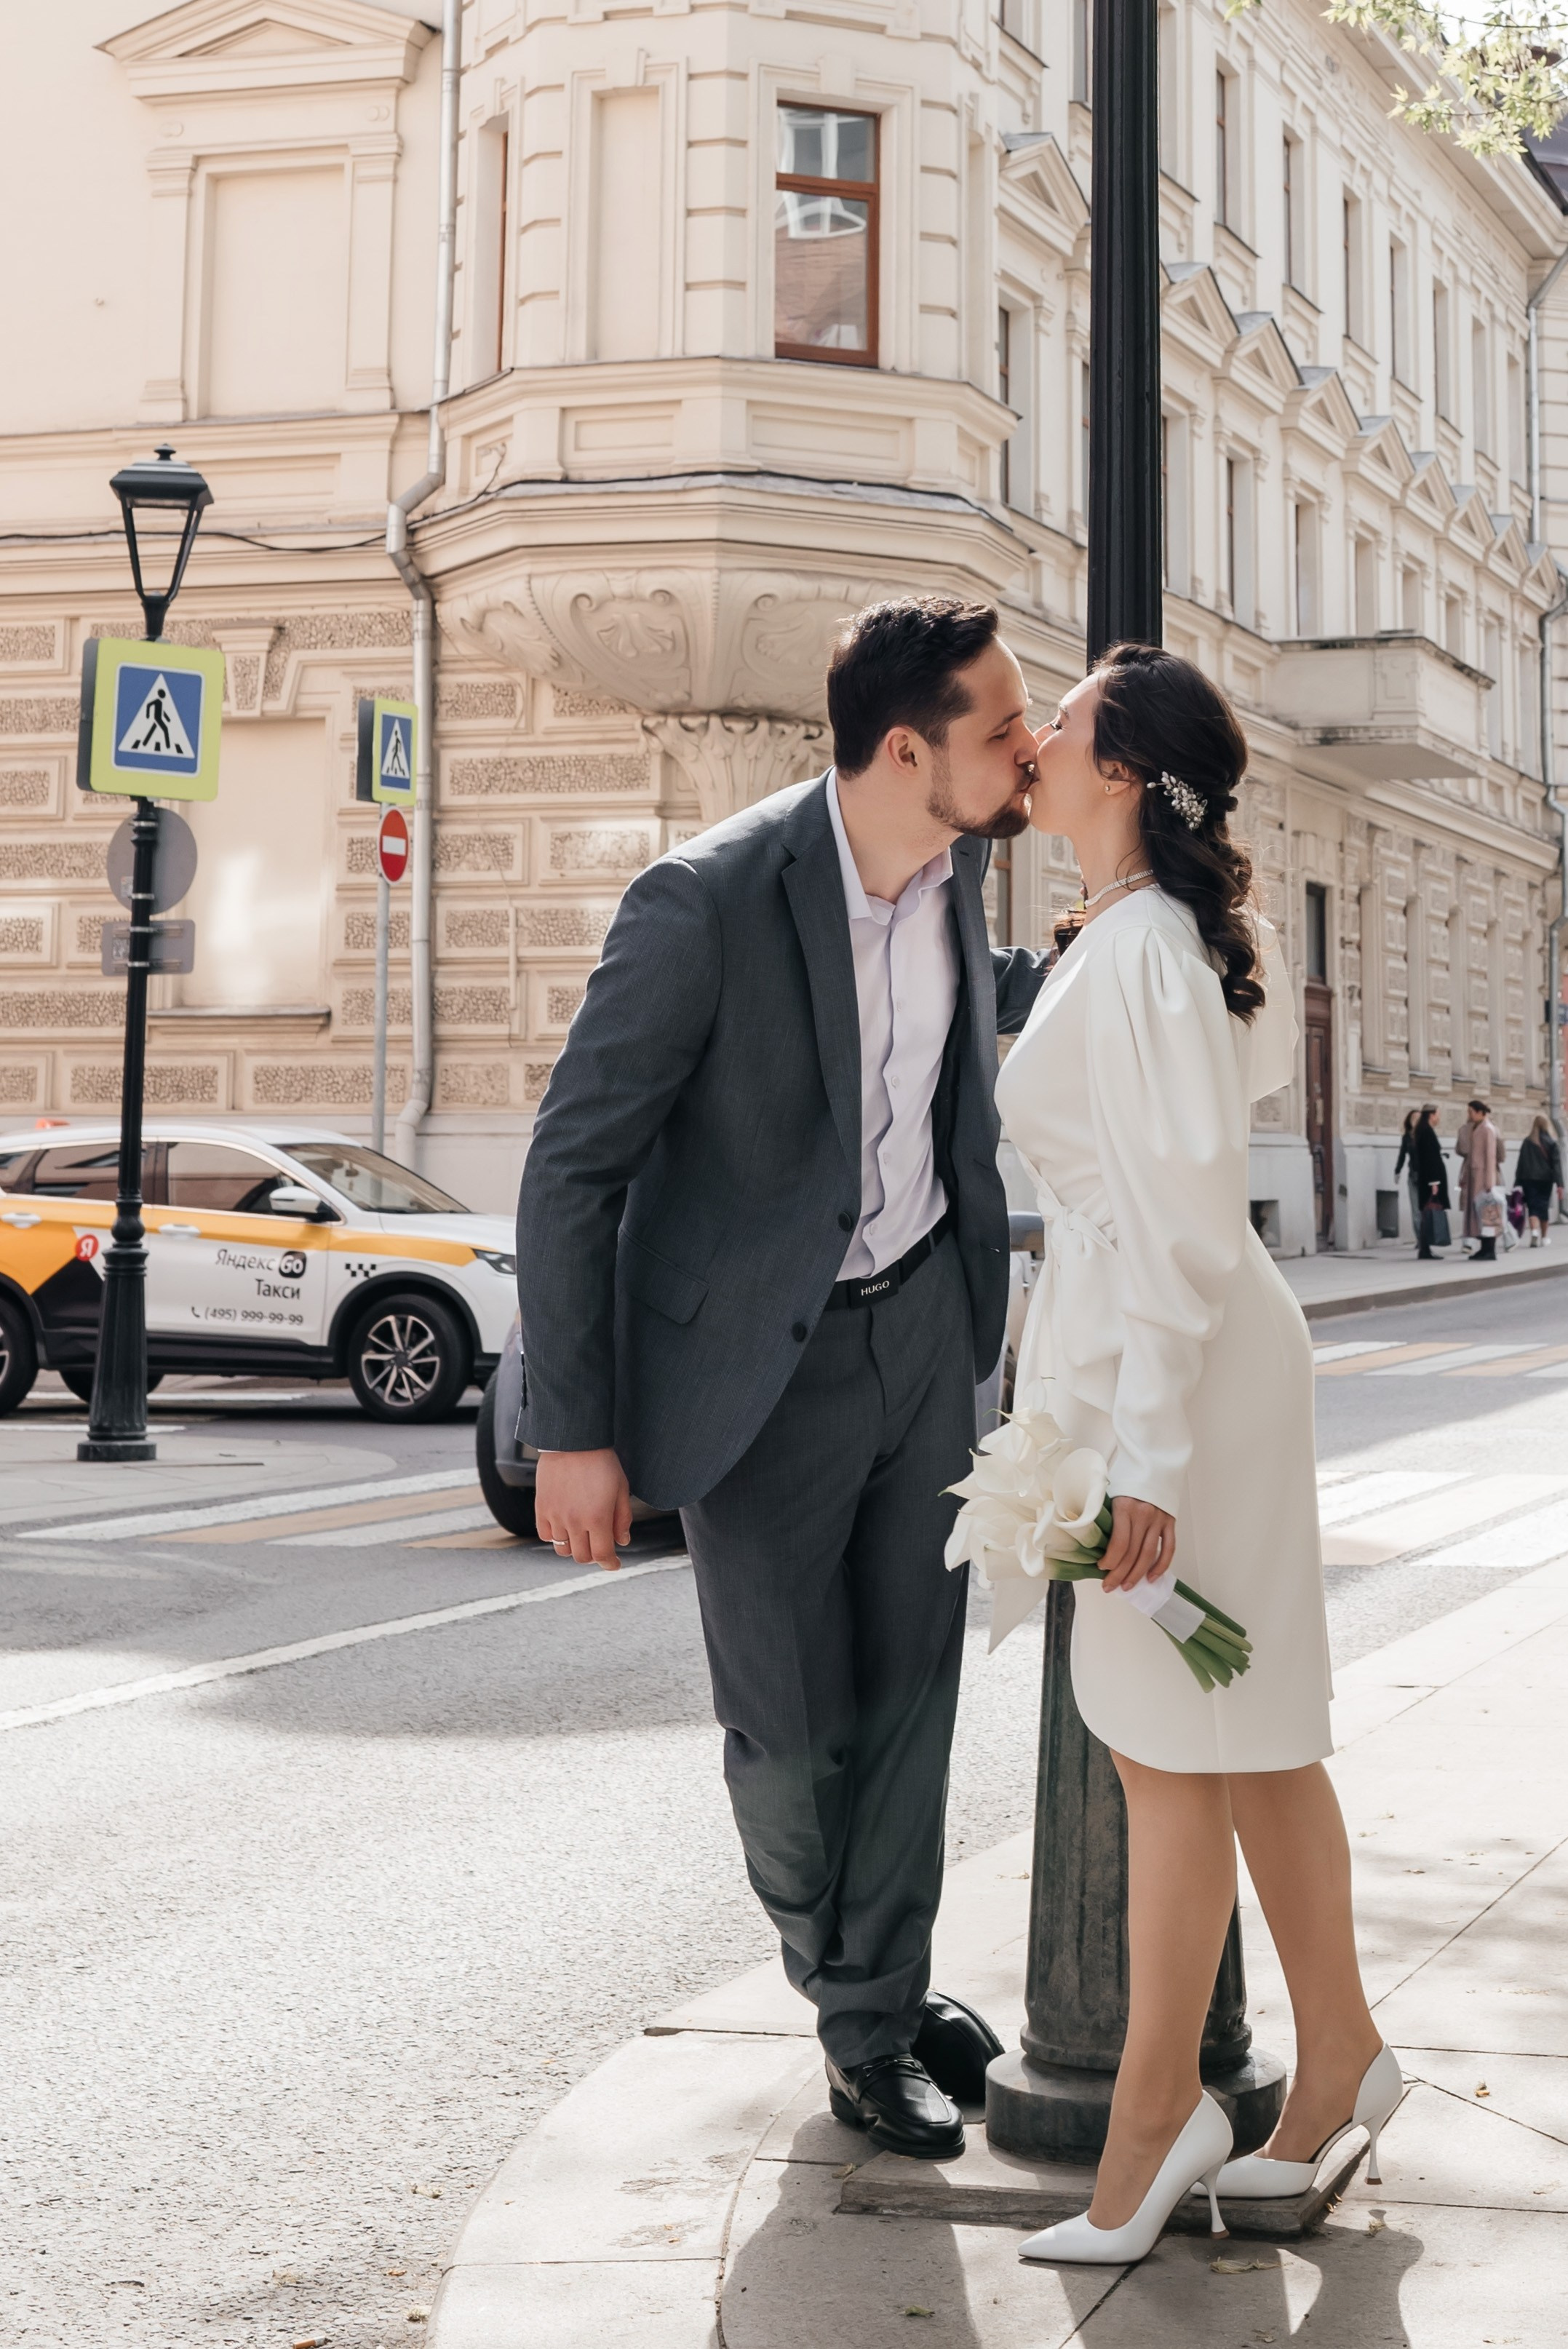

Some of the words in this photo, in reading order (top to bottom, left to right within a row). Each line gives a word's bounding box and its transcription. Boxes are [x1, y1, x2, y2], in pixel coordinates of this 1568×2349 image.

[80, 1239, 94, 1257] Я
[216, 1249, 275, 1271] Яндекс
[280, 1255, 304, 1273] Go
[255, 1279, 301, 1300] Такси
[862, 1281, 890, 1296] HUGO
[204, 1307, 237, 1321] (495)
[241, 1310, 303, 1325] 999-99-99
